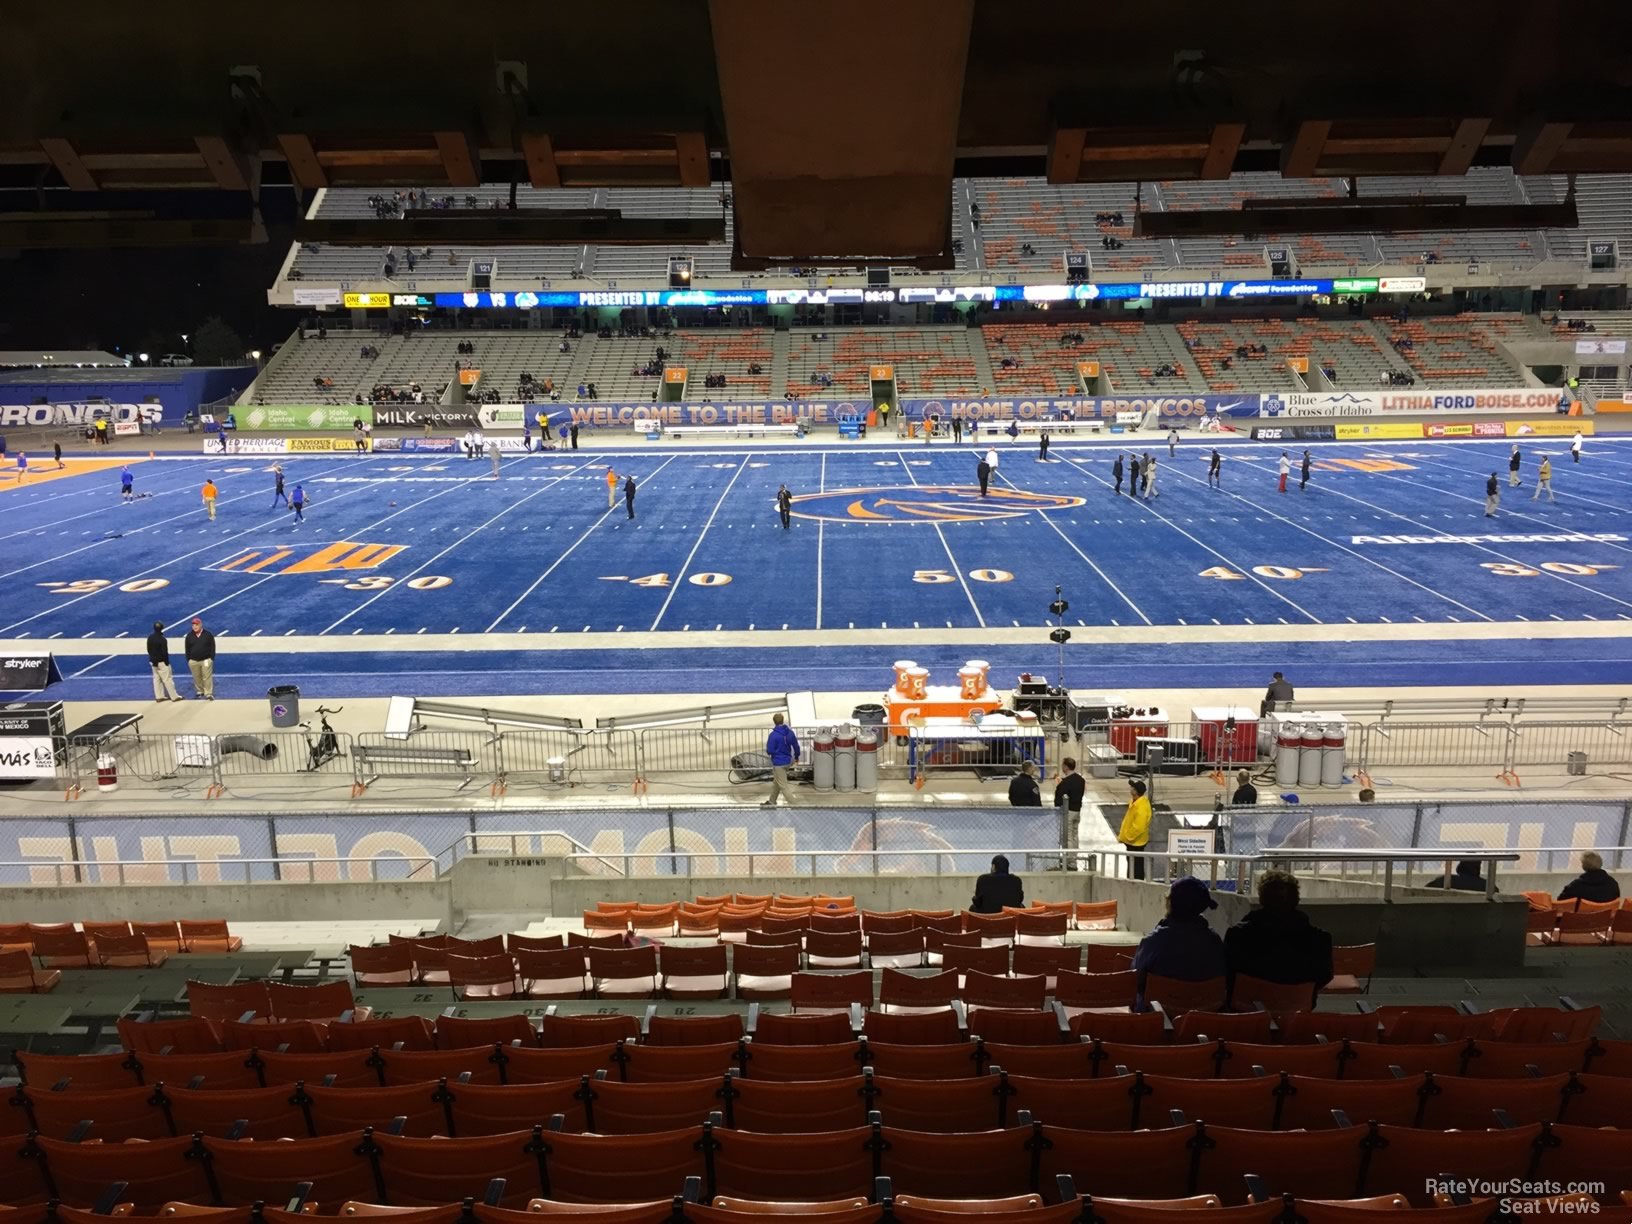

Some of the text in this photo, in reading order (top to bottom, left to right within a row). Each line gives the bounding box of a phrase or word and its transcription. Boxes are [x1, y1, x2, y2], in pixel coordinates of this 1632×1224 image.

[1140, 282, 1224, 298] PRESENTED BY
[1271, 285, 1318, 293] Foundation
[346, 295, 360, 303] ONE
[489, 292, 507, 307] VS
[579, 292, 643, 306] PRESENTED
[1082, 366, 1092, 374] 24
[1289, 395, 1317, 406] Blue
[1382, 393, 1560, 411] LITHIAFORDBOISE.COM
[0, 404, 163, 425] RONCOS
[569, 404, 828, 424] WELCOME TO THE BLUE
[952, 399, 1207, 420] HOME OF THE BRONCOS
[1288, 406, 1372, 417] Cross of Idaho
[376, 411, 417, 424] MILK
[242, 439, 285, 447] HERITAGE
[4, 659, 43, 669] stryker
